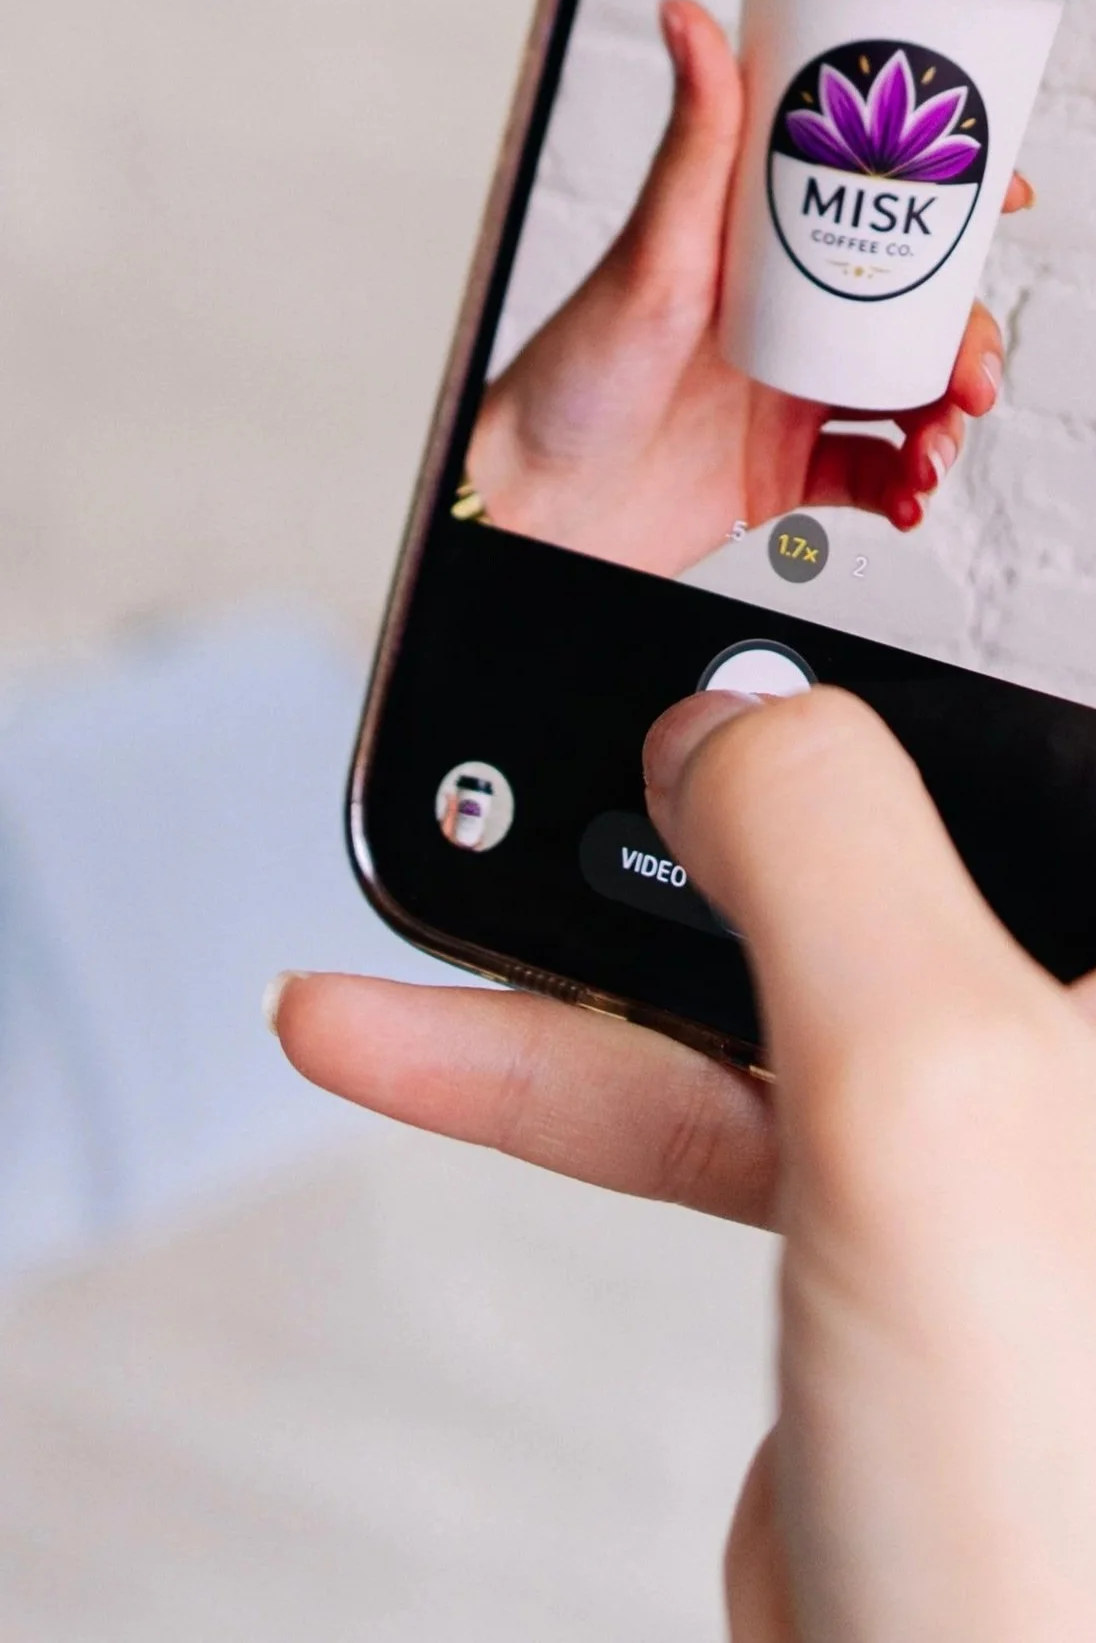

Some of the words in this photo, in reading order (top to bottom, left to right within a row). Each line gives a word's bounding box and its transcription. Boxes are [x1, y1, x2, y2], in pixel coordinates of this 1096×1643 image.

[802, 177, 937, 234] MISK
[811, 230, 878, 254] COFFEE
[886, 243, 914, 257] CO.
[853, 556, 868, 577] 2
[621, 847, 687, 888] VIDEO
